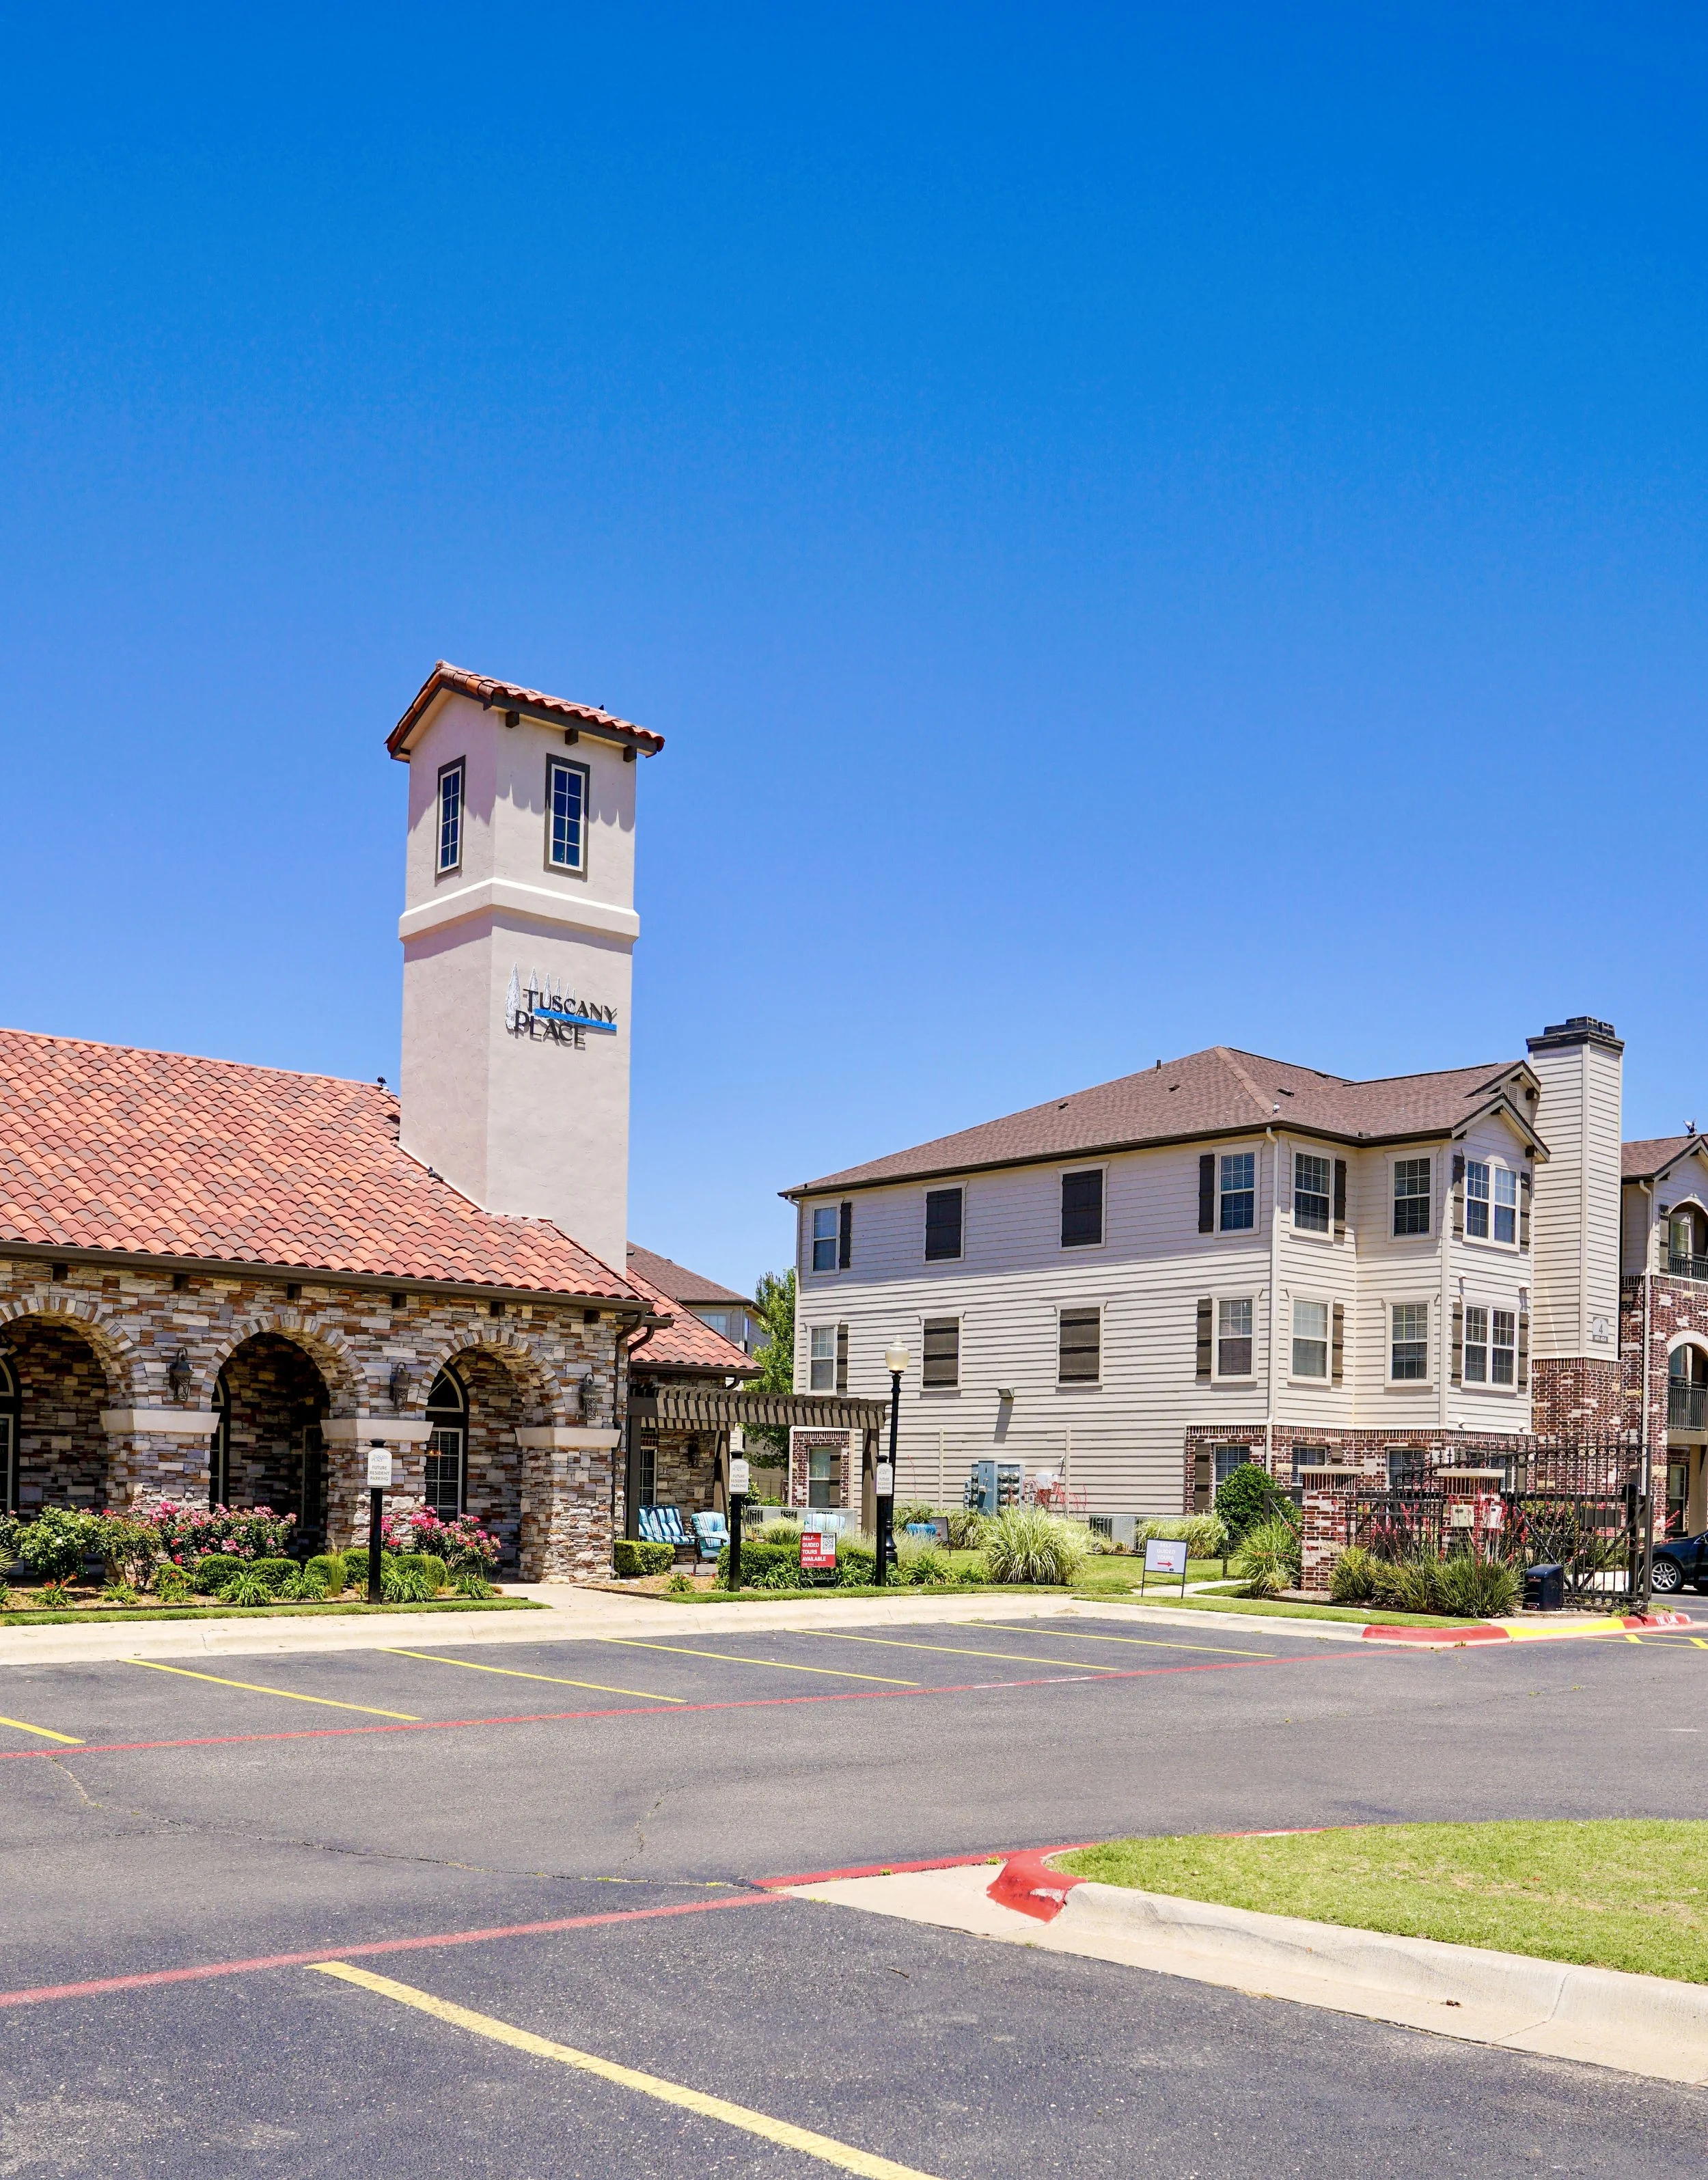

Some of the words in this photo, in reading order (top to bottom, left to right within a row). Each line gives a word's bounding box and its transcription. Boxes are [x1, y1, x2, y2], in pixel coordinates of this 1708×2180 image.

[523, 989, 617, 1023] TUSCANY
[514, 1010, 586, 1045] PLACE
[1599, 1323, 1603, 1334] 4
